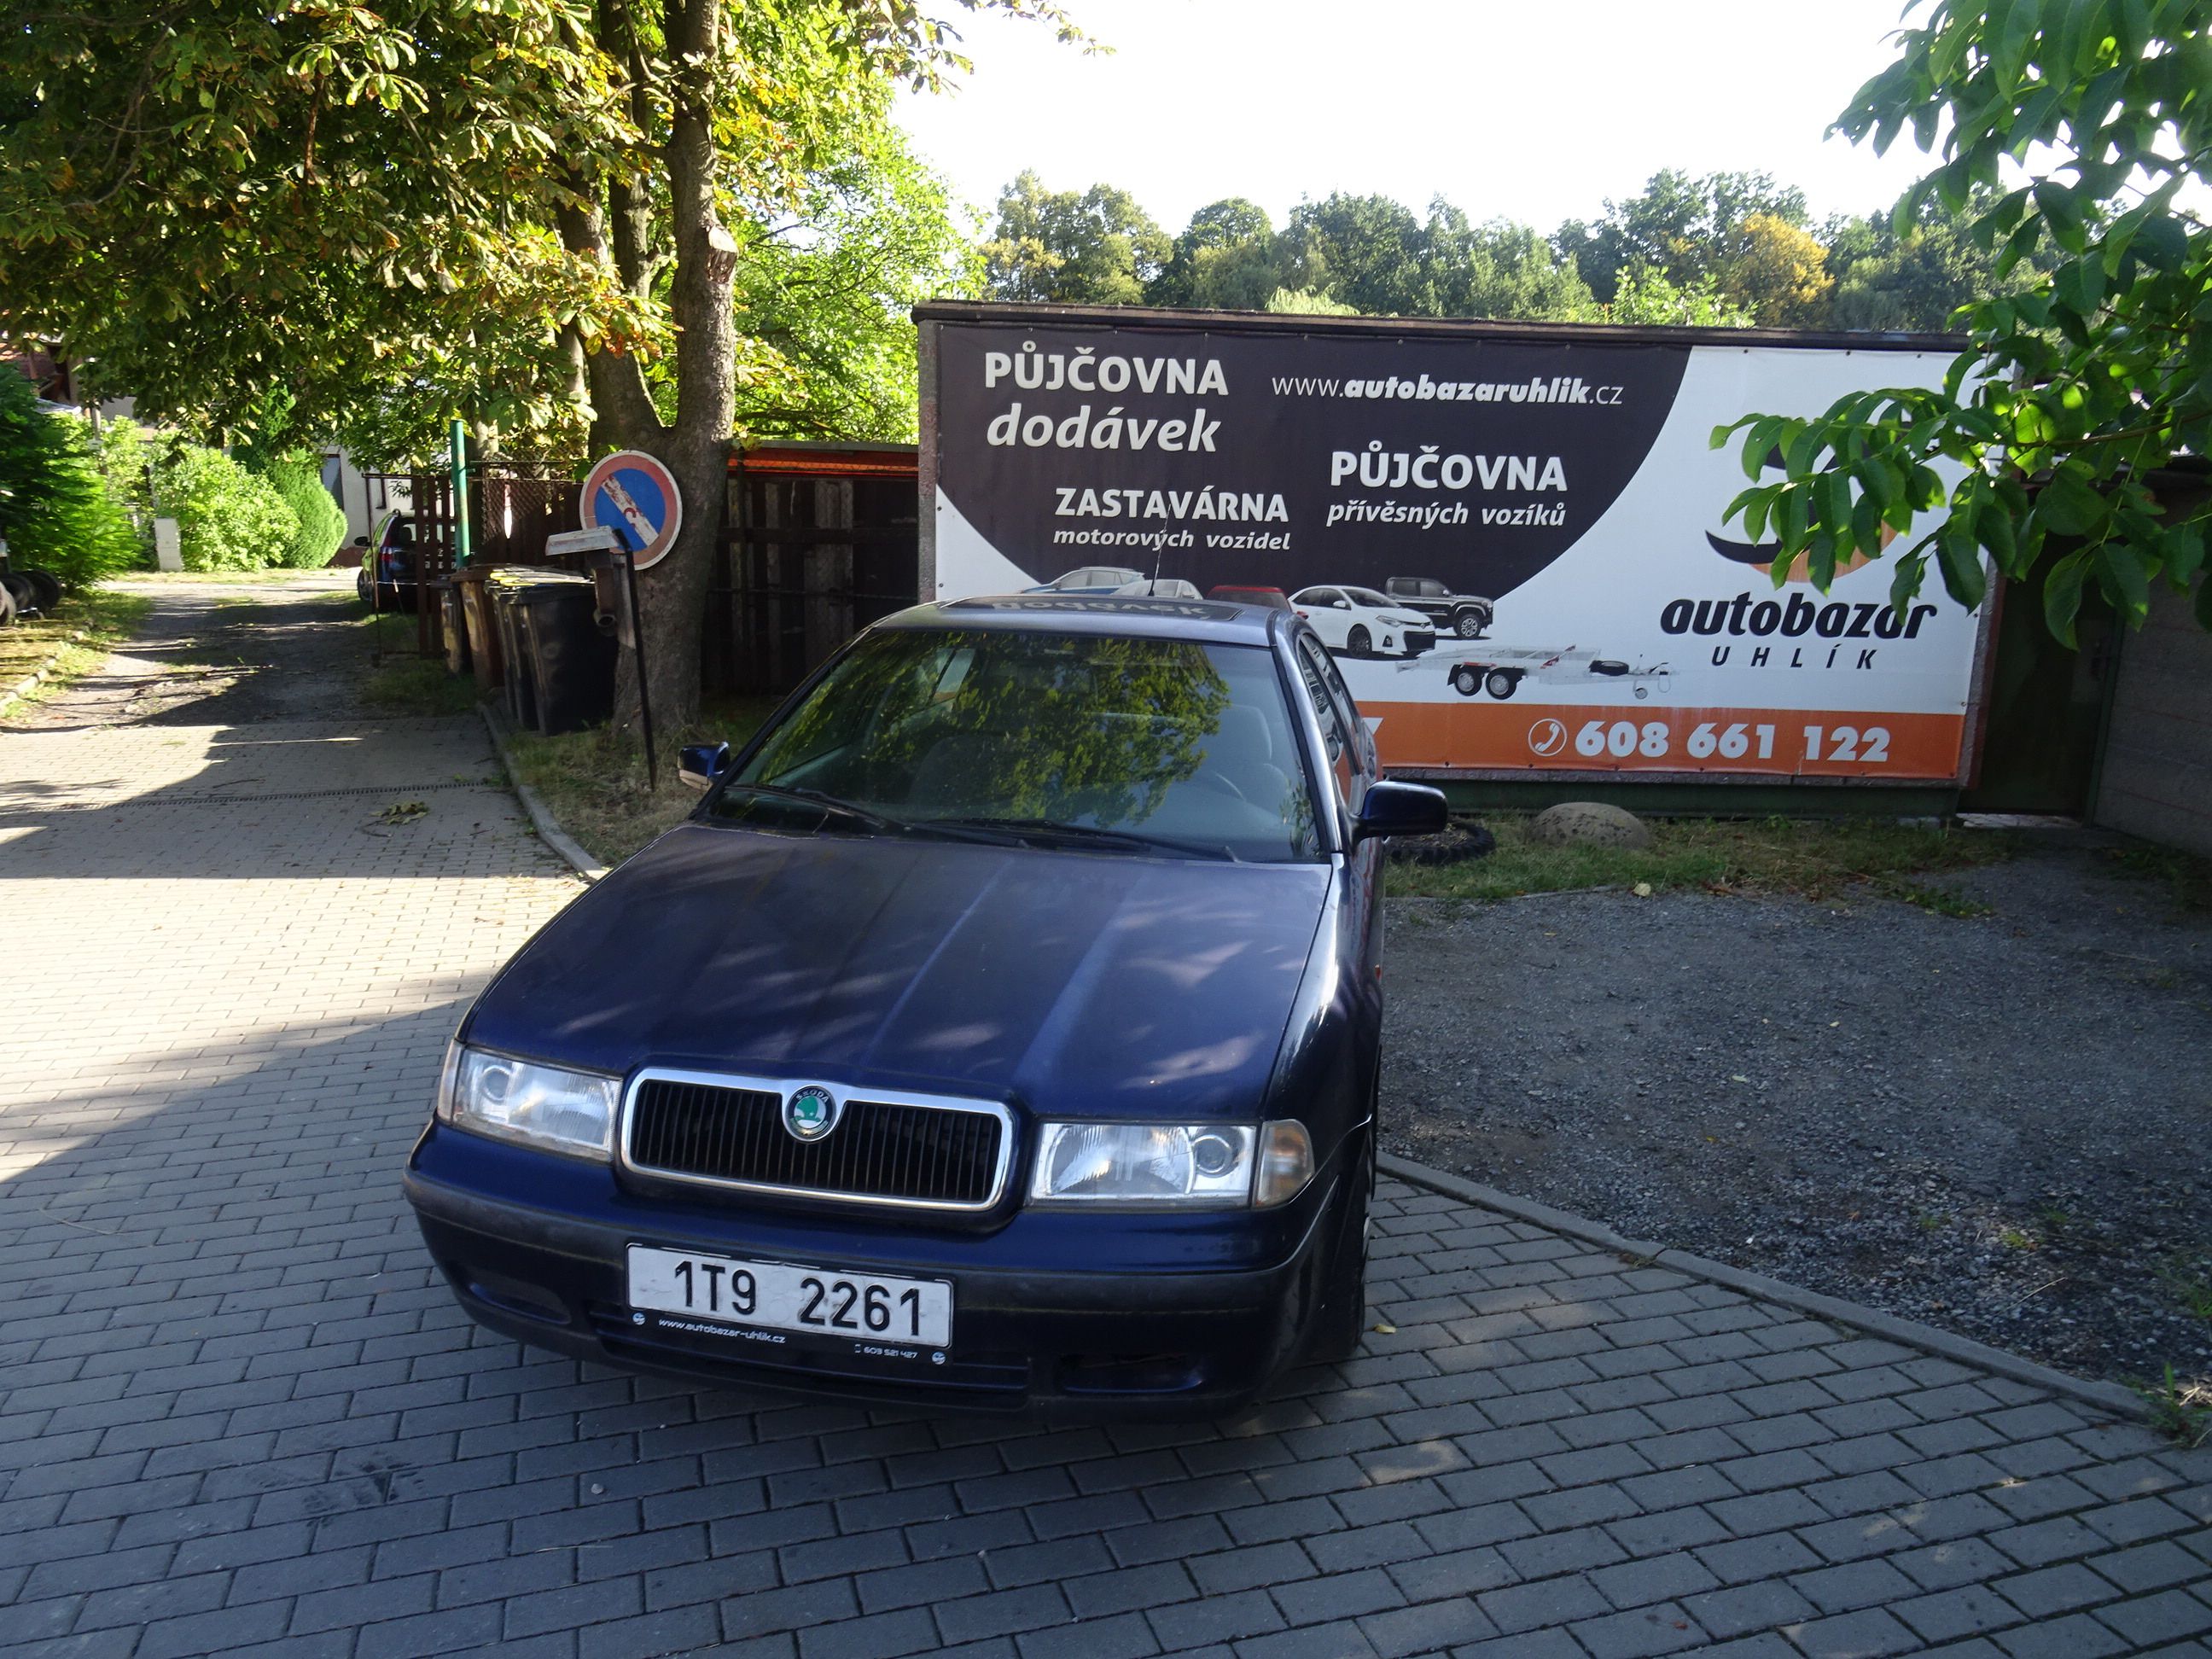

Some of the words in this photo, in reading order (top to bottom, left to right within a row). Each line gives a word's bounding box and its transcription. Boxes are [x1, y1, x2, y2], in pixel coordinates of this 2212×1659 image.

[985, 340, 1229, 396] PŮJČOVNA
[1272, 374, 1624, 405] www.autobazaruhlik.cz
[987, 402, 1221, 452] dodávek
[1330, 439, 1568, 492] PŮJČOVNA
[1055, 485, 1289, 522] ZASTAVÁRNA
[1325, 499, 1468, 530] přívěsných
[1481, 502, 1567, 527] vozíků
[1053, 528, 1195, 551] motorových
[1206, 531, 1291, 550] vozidel
[1660, 591, 1938, 639] autobazar
[1711, 643, 1877, 670] UHLÍK
[1575, 720, 1669, 758] 608
[1686, 722, 1775, 759] 661
[1803, 725, 1891, 762] 122
[674, 1260, 757, 1316] 1T9
[798, 1277, 921, 1336] 2261
